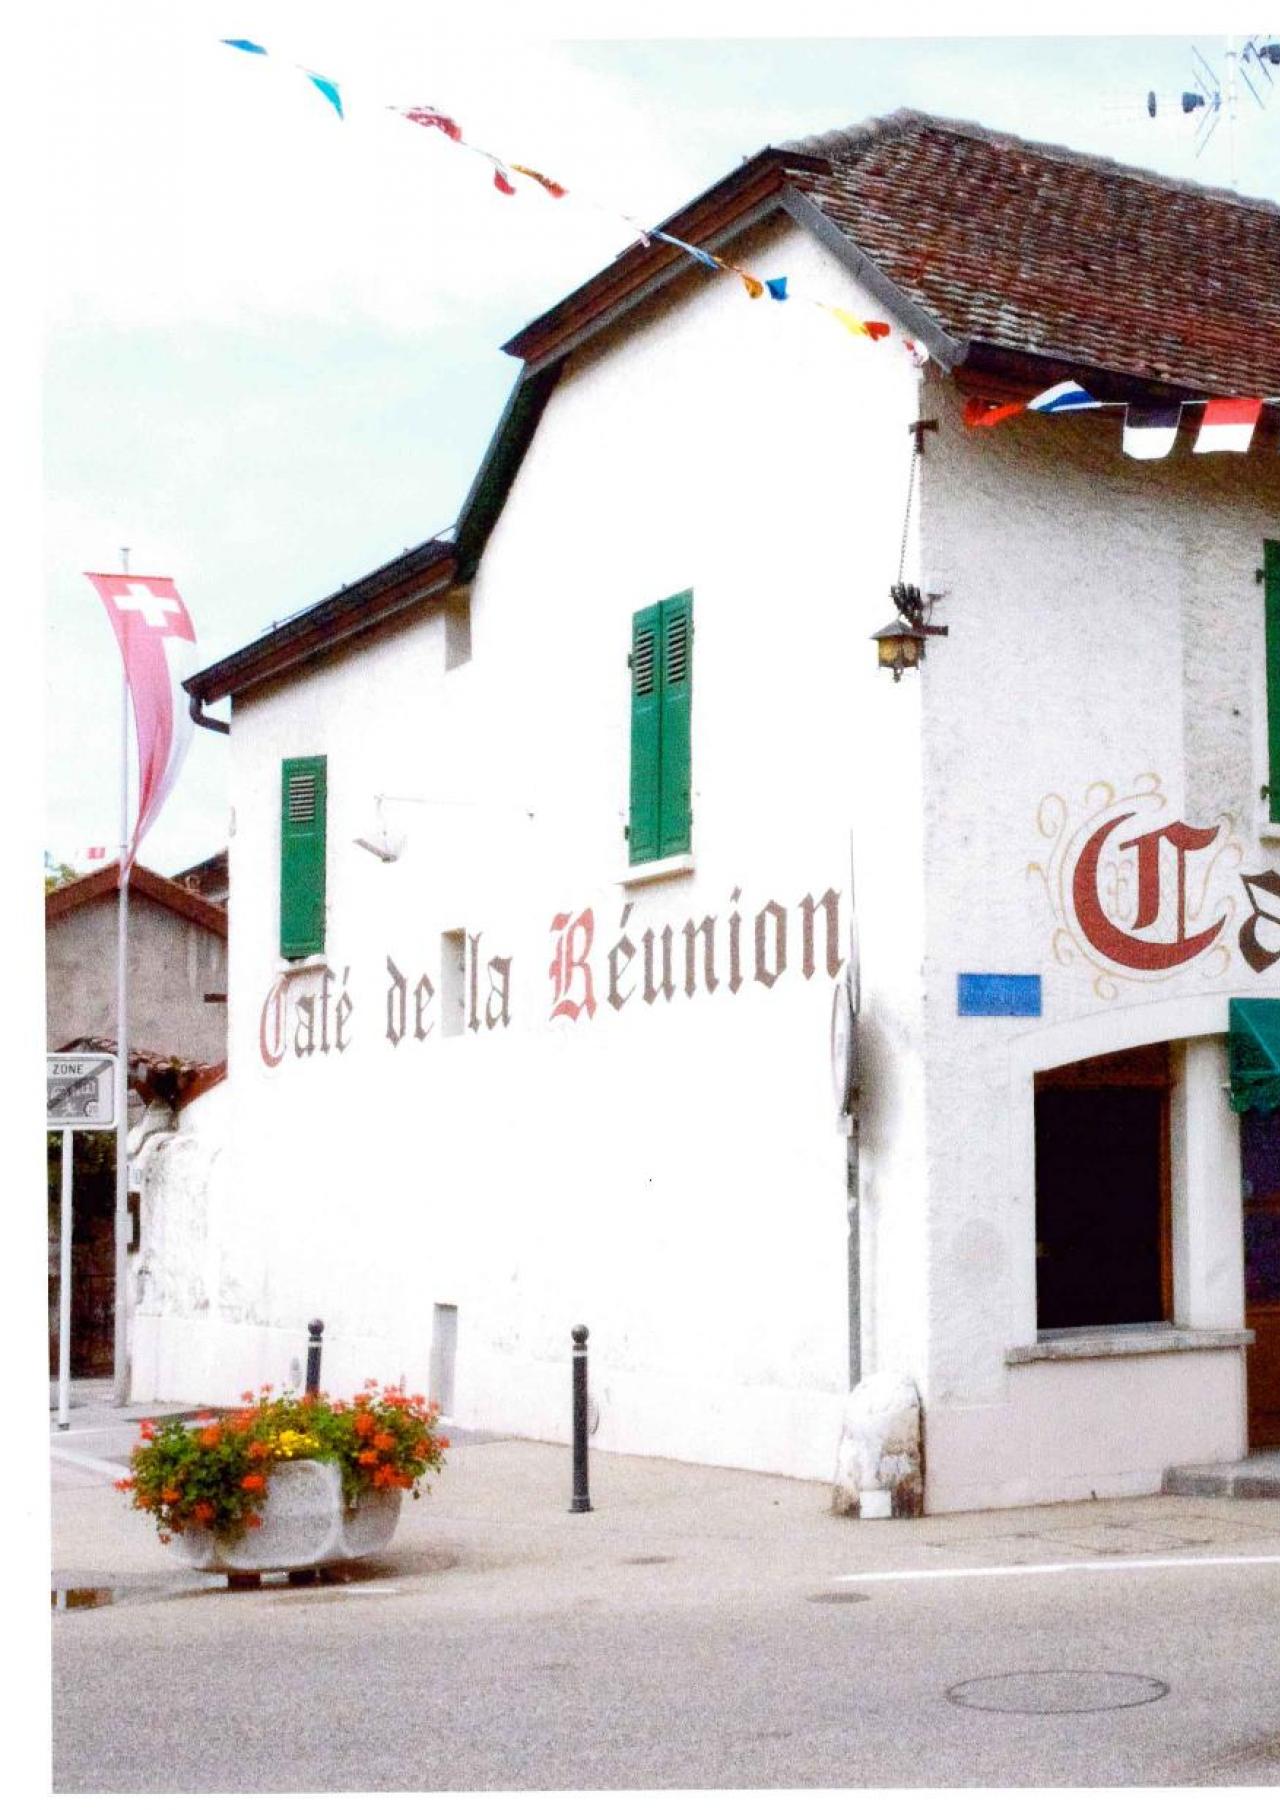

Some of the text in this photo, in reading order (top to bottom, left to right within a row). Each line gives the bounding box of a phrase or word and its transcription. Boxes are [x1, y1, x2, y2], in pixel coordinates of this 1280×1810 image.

[260, 886, 845, 1068] Café de la Réunion
[52, 1063, 84, 1075] ZONE
